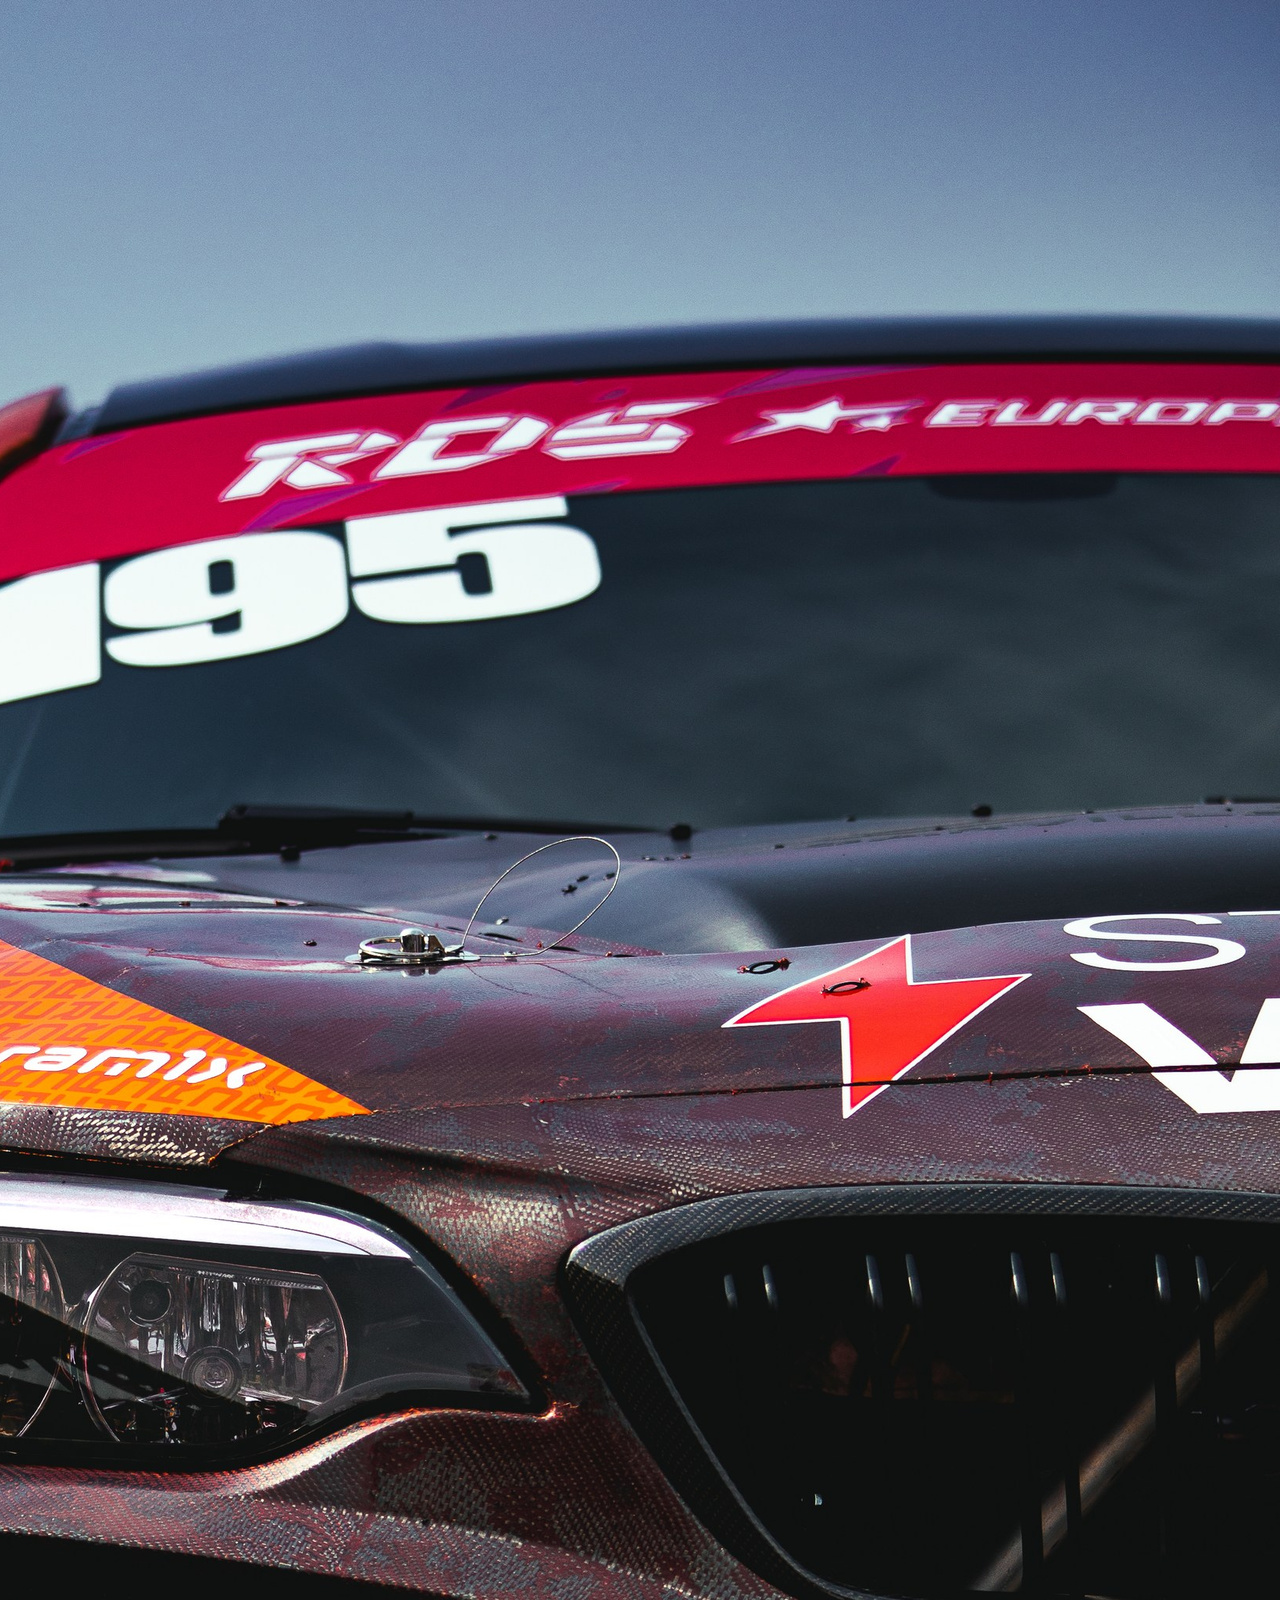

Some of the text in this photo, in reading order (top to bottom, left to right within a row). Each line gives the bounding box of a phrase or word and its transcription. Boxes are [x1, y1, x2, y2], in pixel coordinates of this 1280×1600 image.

[220, 397, 1280, 502] RDS EUROP
[1063, 910, 1280, 972] S
